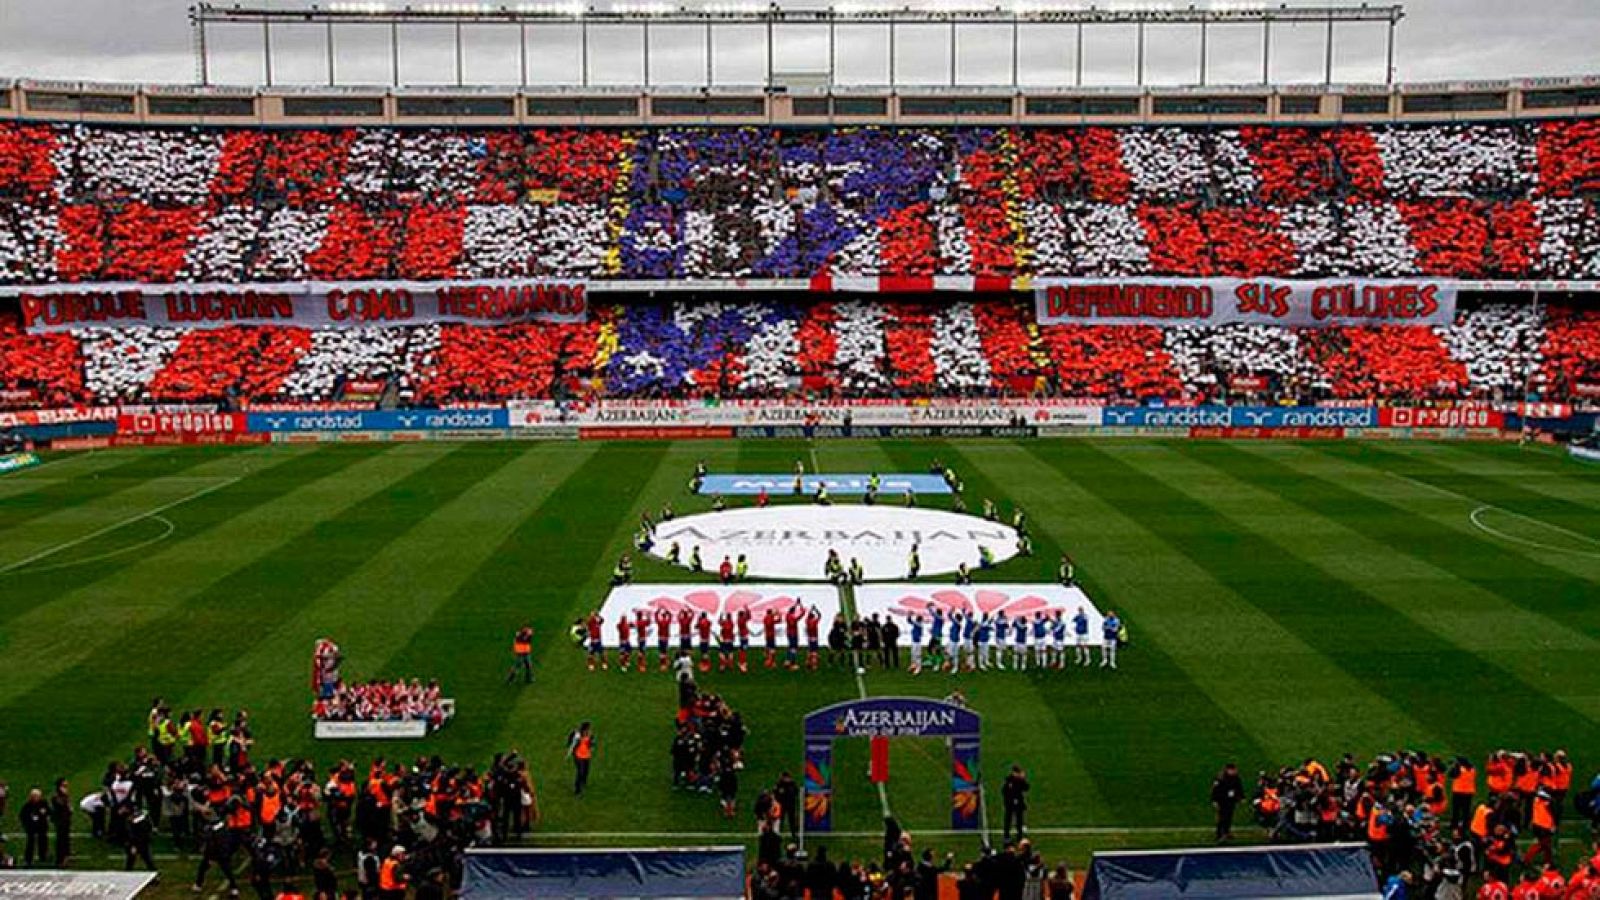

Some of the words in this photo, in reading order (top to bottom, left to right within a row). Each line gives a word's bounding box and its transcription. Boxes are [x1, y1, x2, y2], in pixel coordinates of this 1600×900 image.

[20, 291, 146, 327] PORQUE
[164, 291, 293, 321] LUCHAN
[326, 288, 414, 321] COMO
[436, 284, 586, 318] HERMANOS
[1047, 284, 1213, 318] DEFENDIENDO
[1235, 282, 1292, 318] SUS
[1310, 283, 1439, 319] COLORES
[160, 412, 233, 433] redpiso
[294, 413, 362, 429] randstad
[426, 411, 493, 427] randstad
[1145, 406, 1232, 427] randstad
[1282, 406, 1371, 427] randstad
[844, 707, 956, 730] AZERBAIJAN
